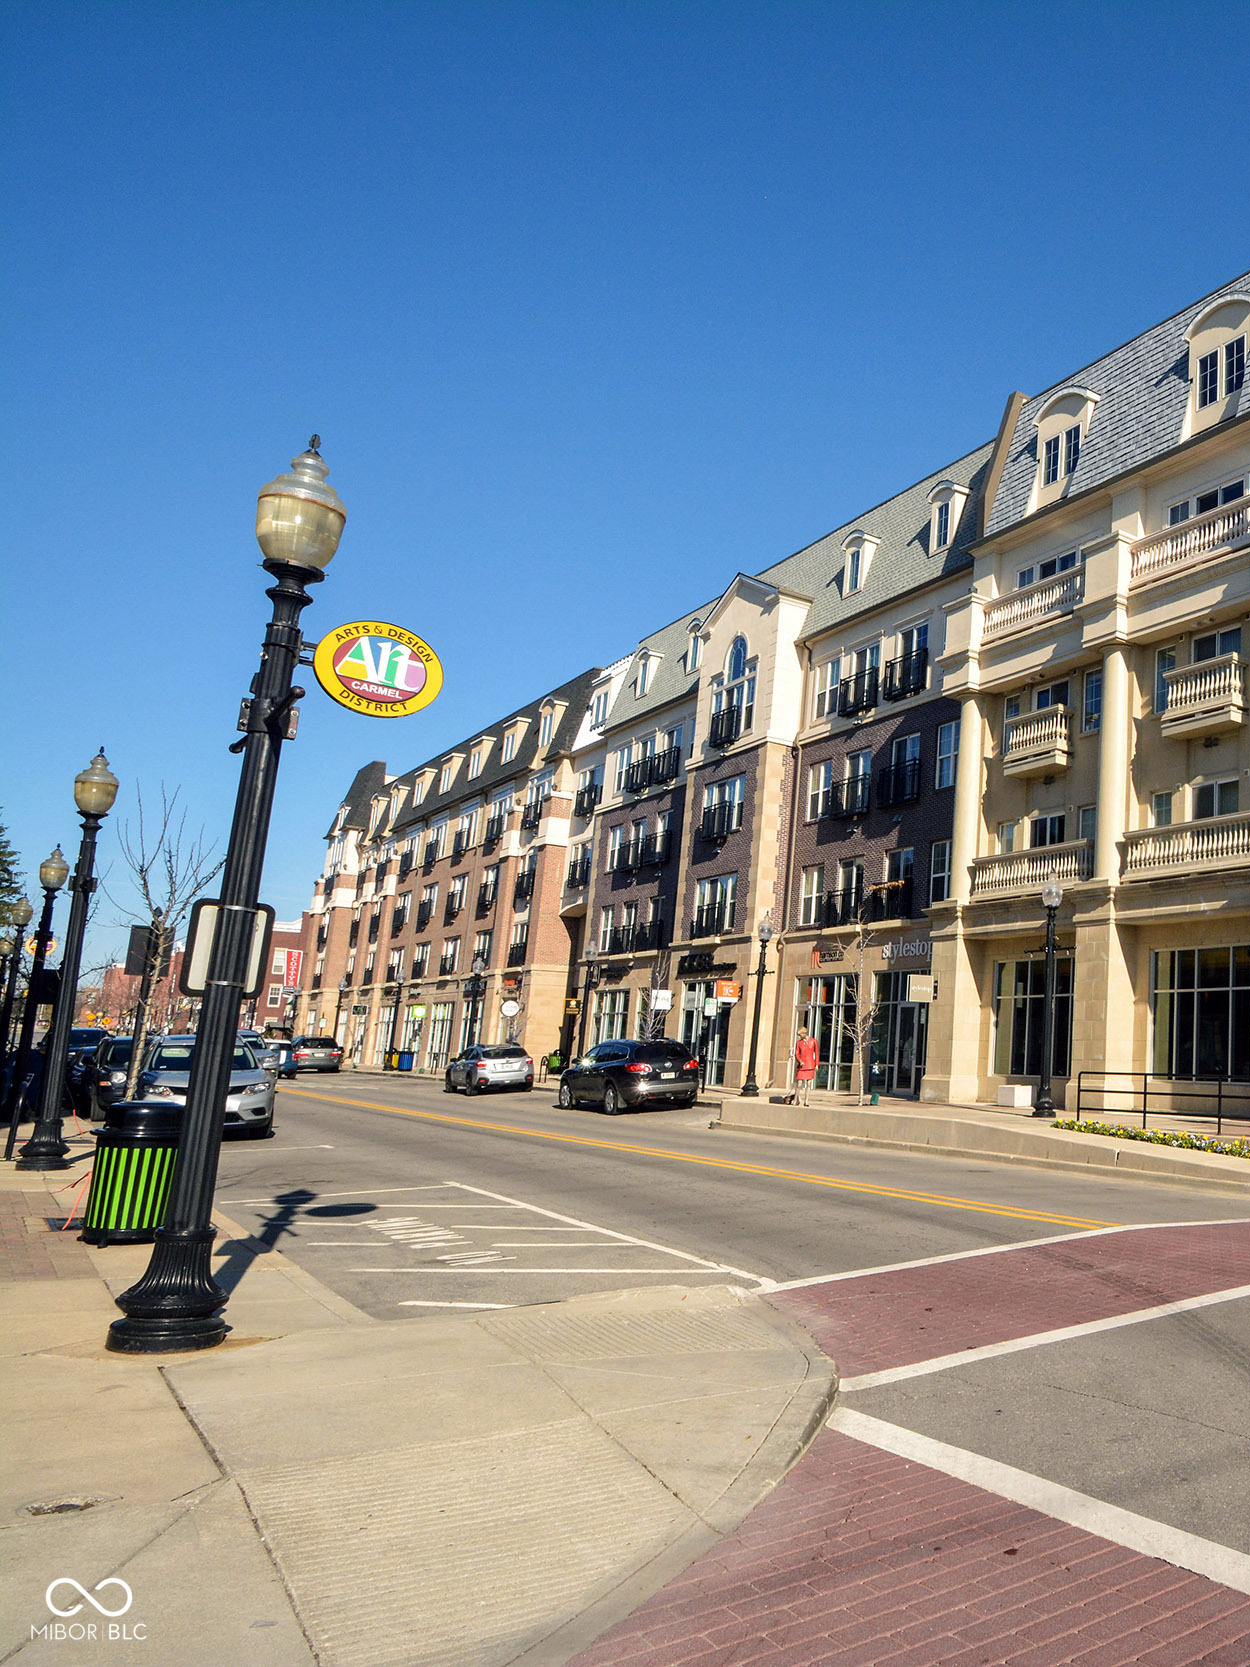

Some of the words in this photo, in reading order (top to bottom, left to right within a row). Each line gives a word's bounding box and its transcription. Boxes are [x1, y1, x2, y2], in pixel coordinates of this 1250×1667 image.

[335, 625, 371, 642] ARTS
[374, 626, 383, 635] &
[388, 628, 433, 663] DESIGN
[335, 636, 425, 693] Art
[339, 689, 408, 712] DISTRICT
[351, 680, 403, 699] CARMEL
[882, 936, 933, 965] stylestop
